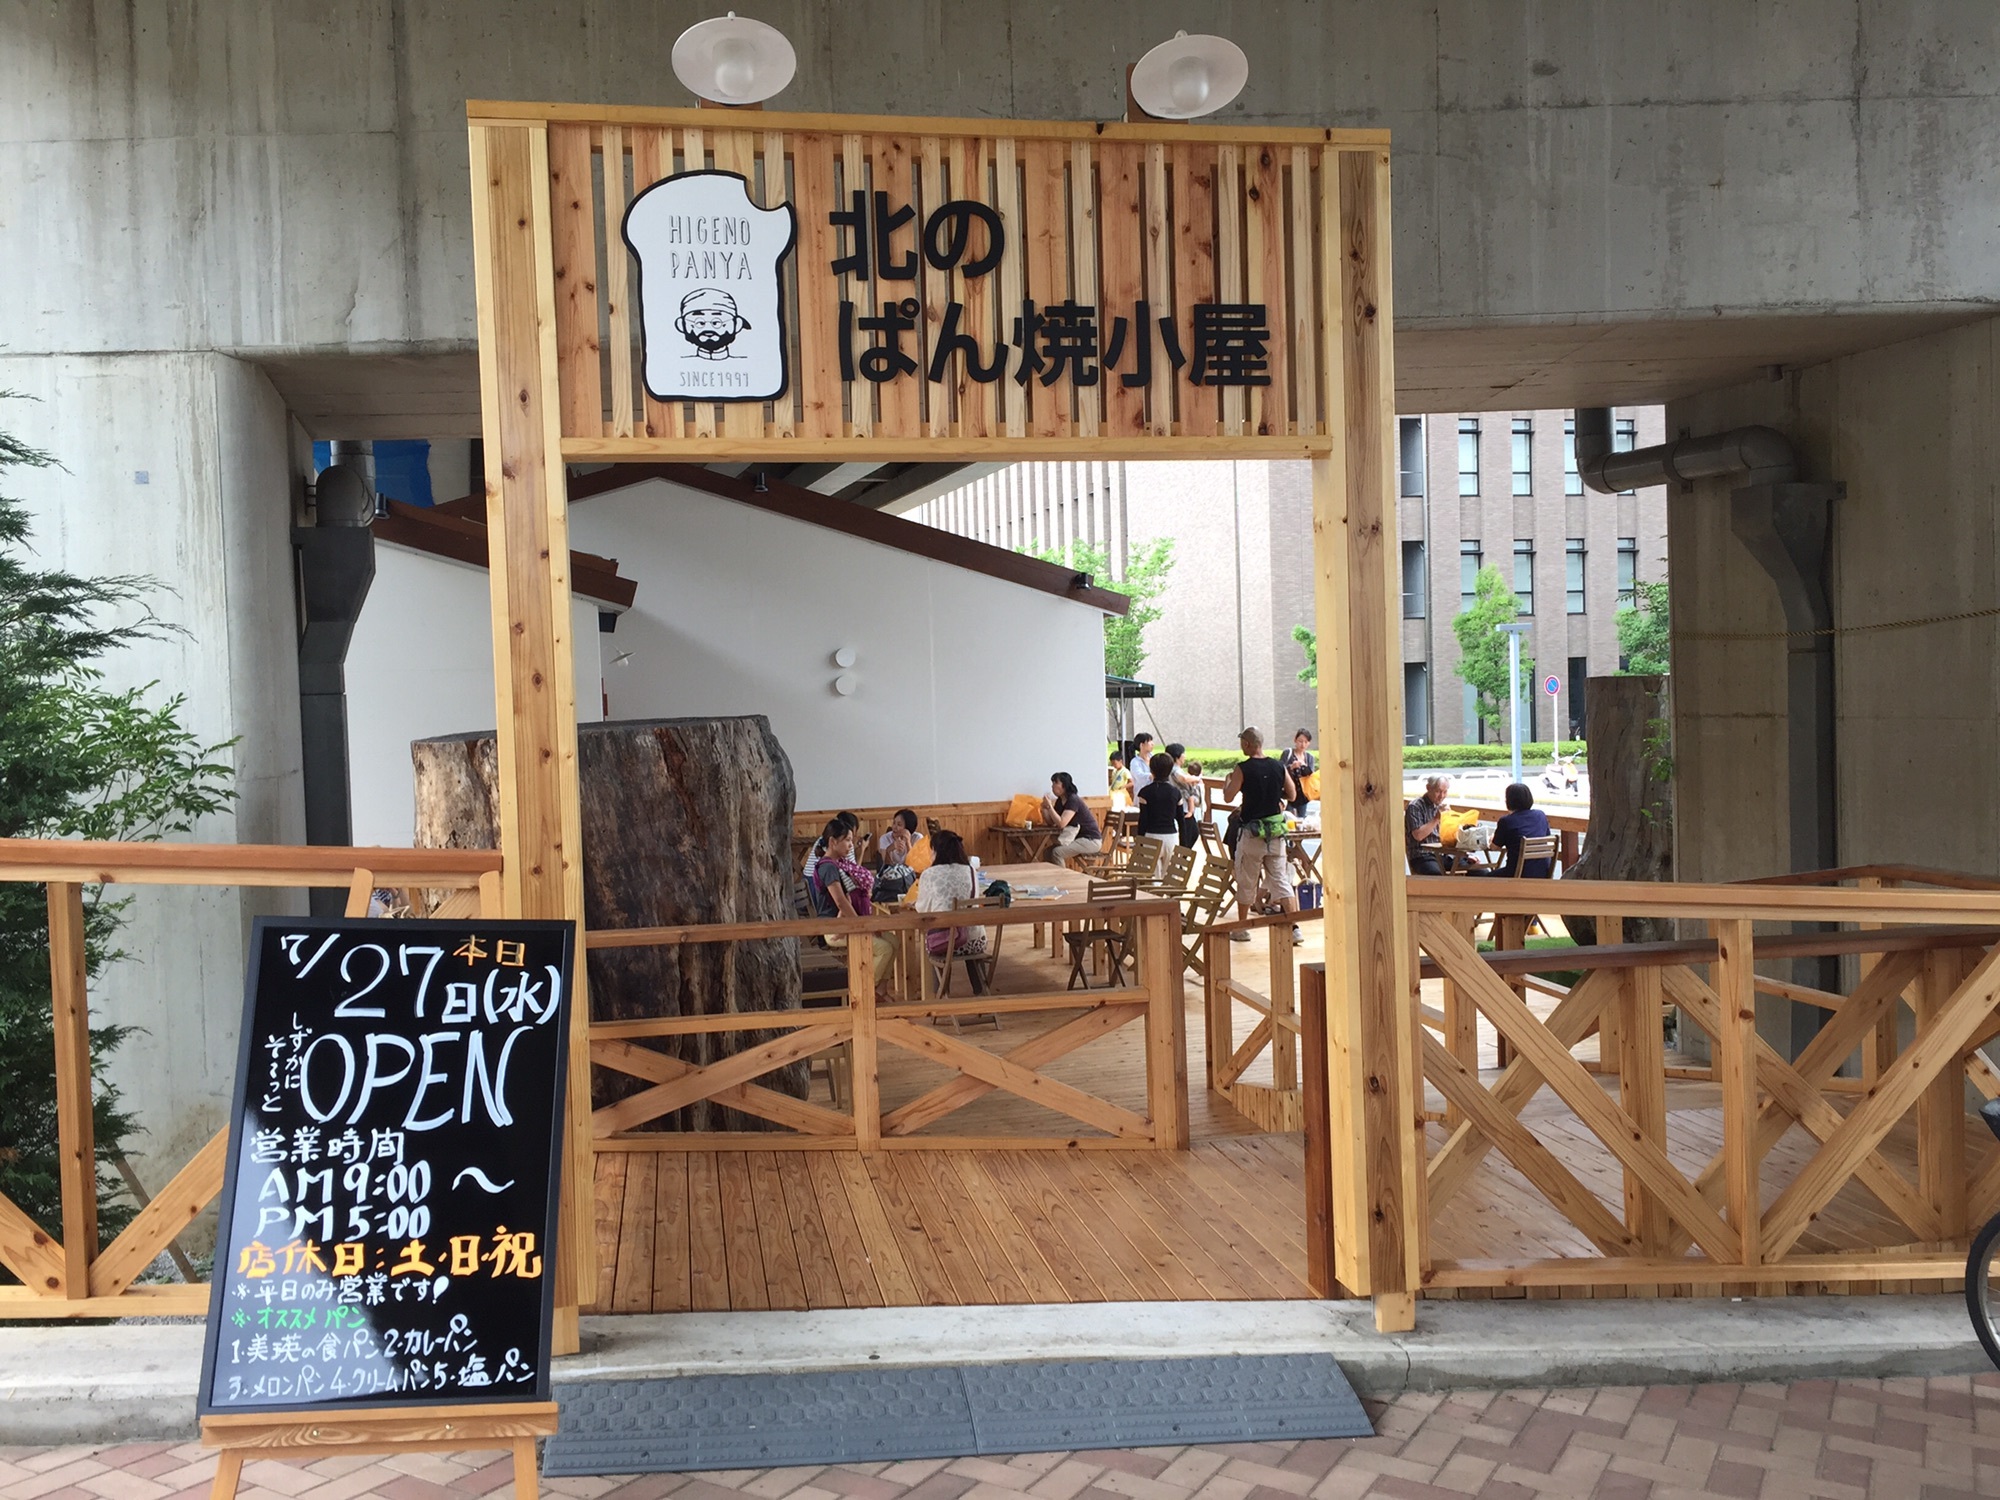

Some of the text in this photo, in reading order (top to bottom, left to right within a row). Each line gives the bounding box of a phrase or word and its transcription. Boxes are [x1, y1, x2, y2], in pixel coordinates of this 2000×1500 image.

[668, 215, 751, 246] HIGENO
[829, 190, 1005, 281] 北の
[670, 250, 752, 280] PANYA
[838, 297, 1271, 388] ぱん焼小屋
[453, 934, 525, 967] 本日
[284, 1011, 312, 1089] しずかに
[300, 1026, 534, 1132] OPEN
[249, 1126, 405, 1165] 営業時間
